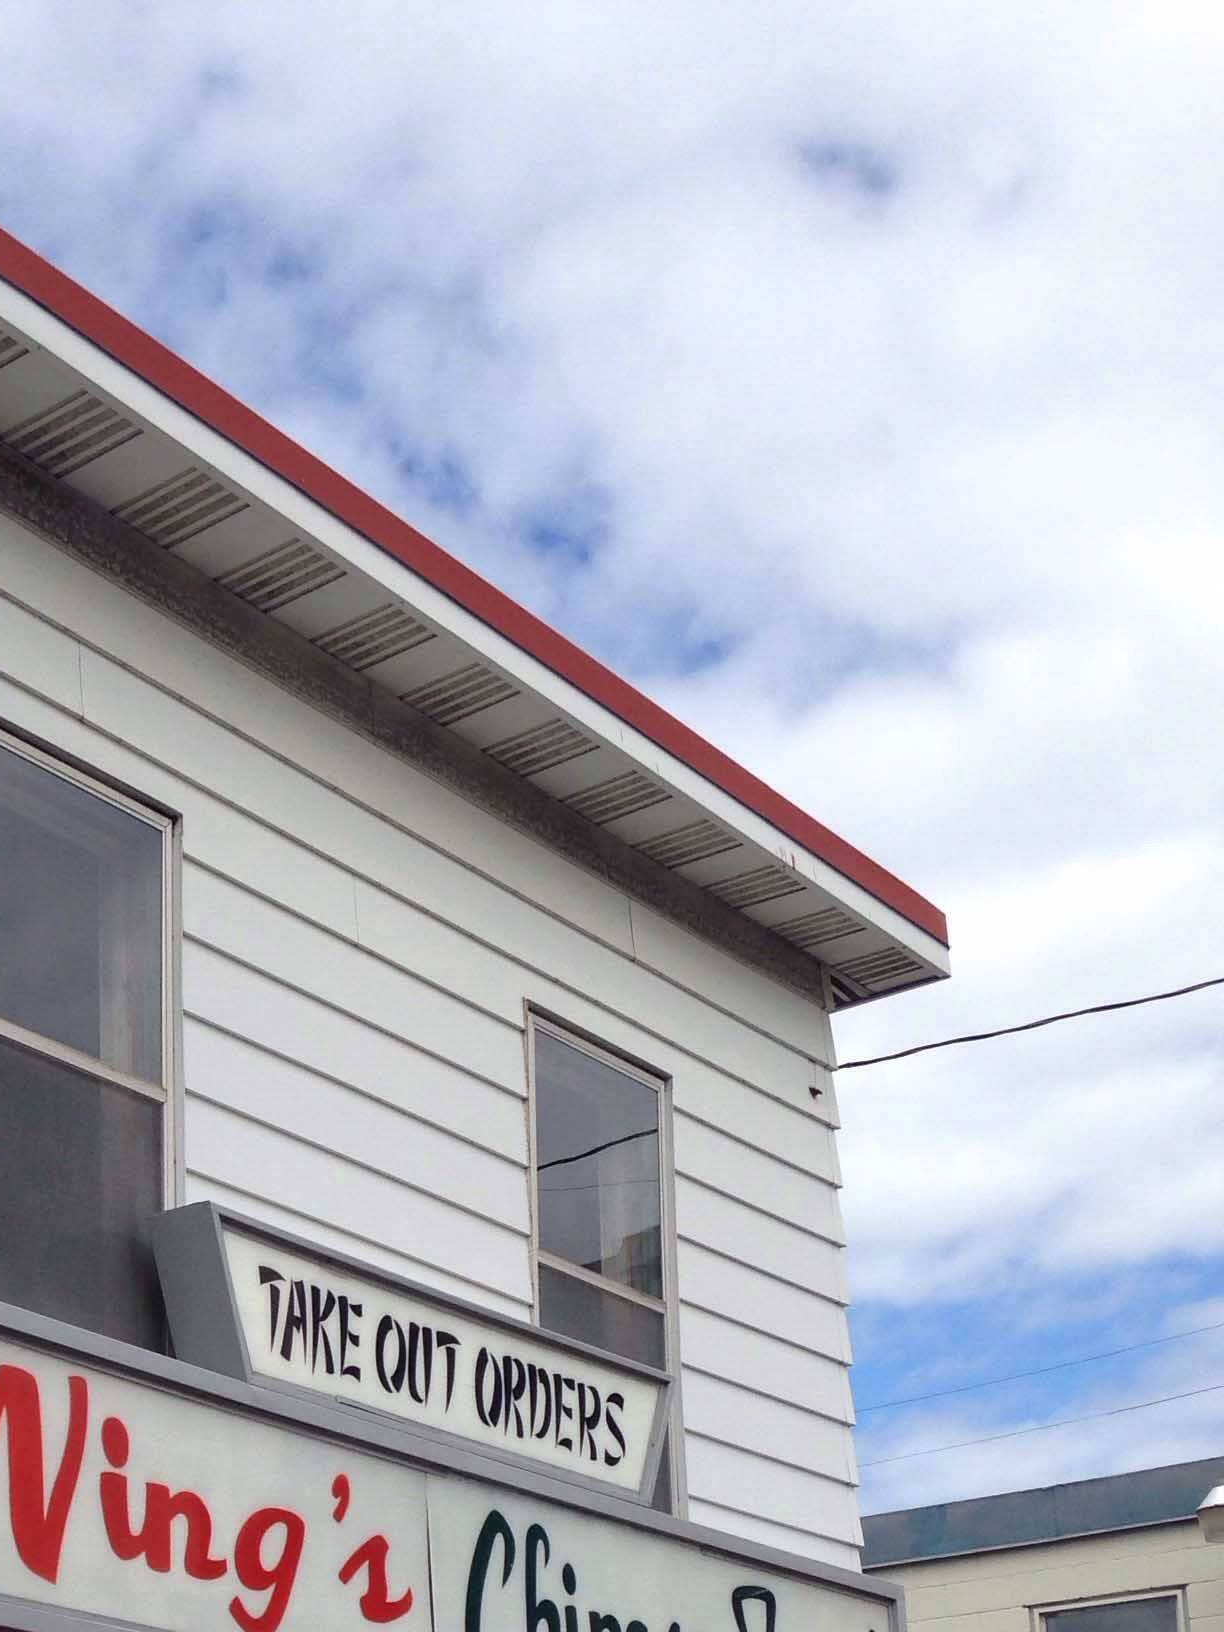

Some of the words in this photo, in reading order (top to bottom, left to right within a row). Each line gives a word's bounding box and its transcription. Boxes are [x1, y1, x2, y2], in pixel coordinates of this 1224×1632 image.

[258, 1265, 363, 1382] TAKE
[376, 1314, 461, 1414] OUT
[475, 1346, 626, 1467] ORDERS
